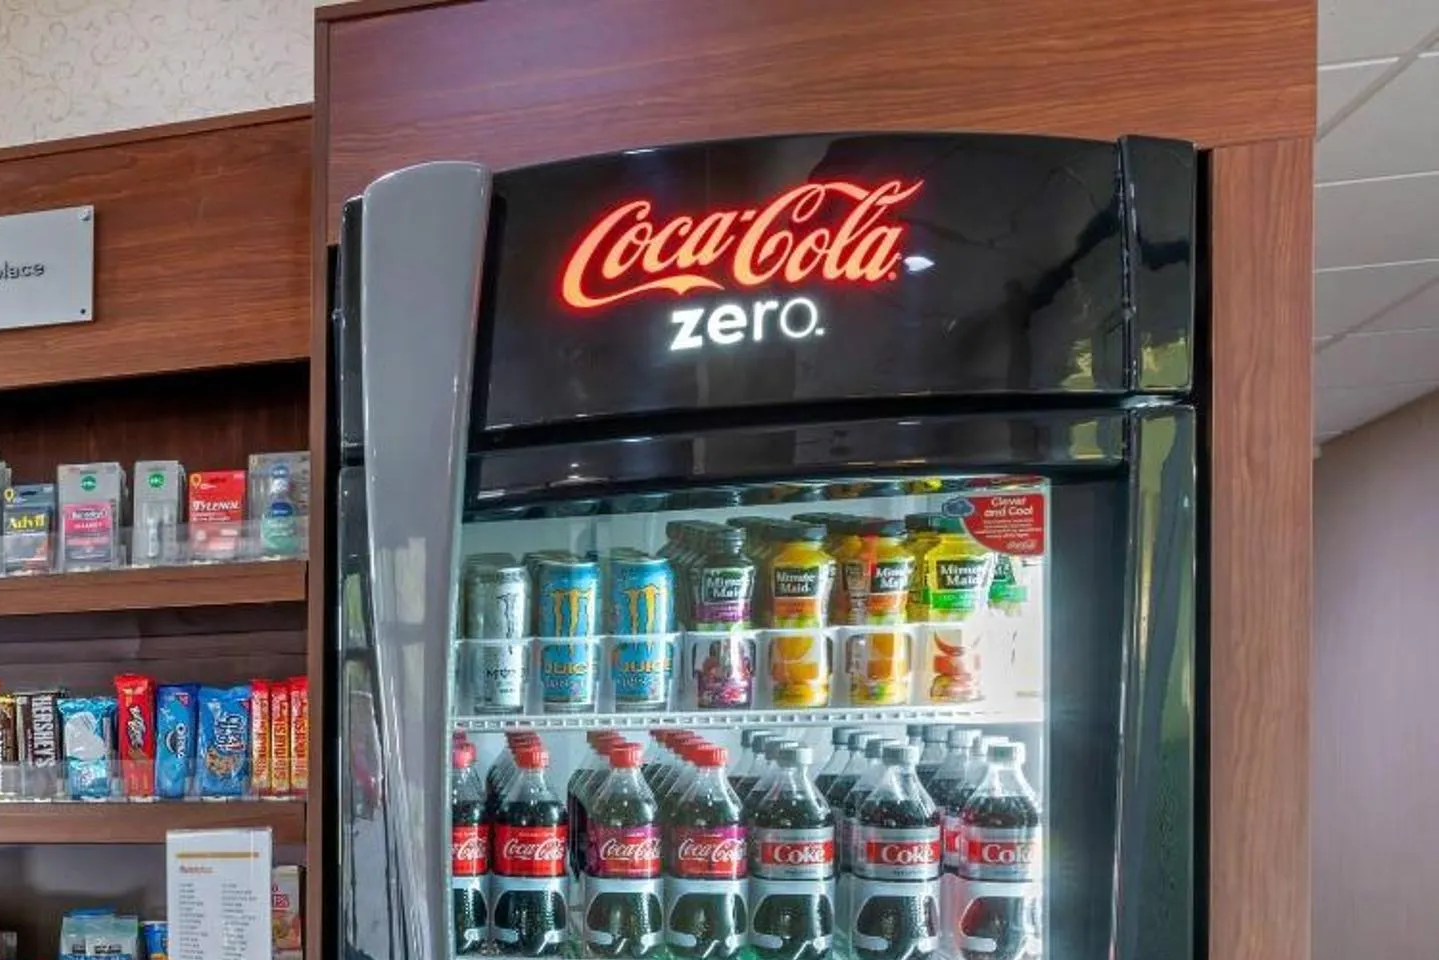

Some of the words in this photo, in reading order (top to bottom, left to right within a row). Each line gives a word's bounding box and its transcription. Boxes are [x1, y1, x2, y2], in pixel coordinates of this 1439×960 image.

[562, 180, 924, 308] Coca-Cola
[984, 506, 1005, 517] and
[1009, 505, 1033, 517] Cool
[9, 513, 45, 530] Advil
